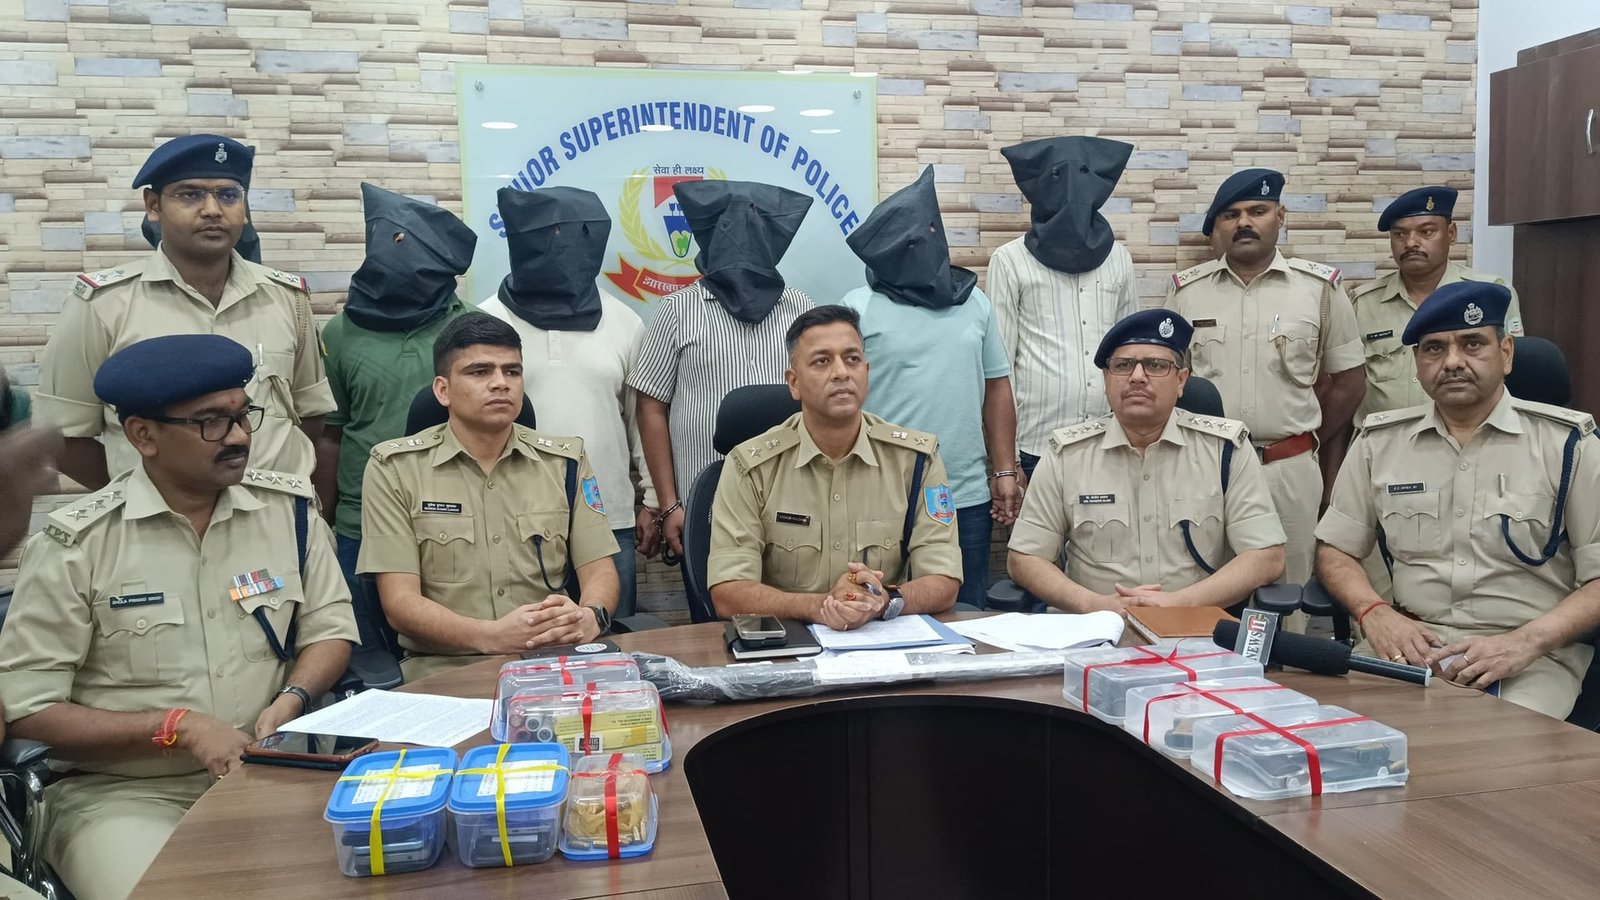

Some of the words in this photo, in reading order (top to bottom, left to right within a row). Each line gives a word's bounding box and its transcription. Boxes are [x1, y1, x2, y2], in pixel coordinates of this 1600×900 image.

[559, 101, 756, 161] SUPERINTENDENT
[760, 124, 790, 159] OF
[791, 145, 860, 236] POLICE
[653, 163, 670, 175] सेवा
[672, 163, 682, 175] ही
